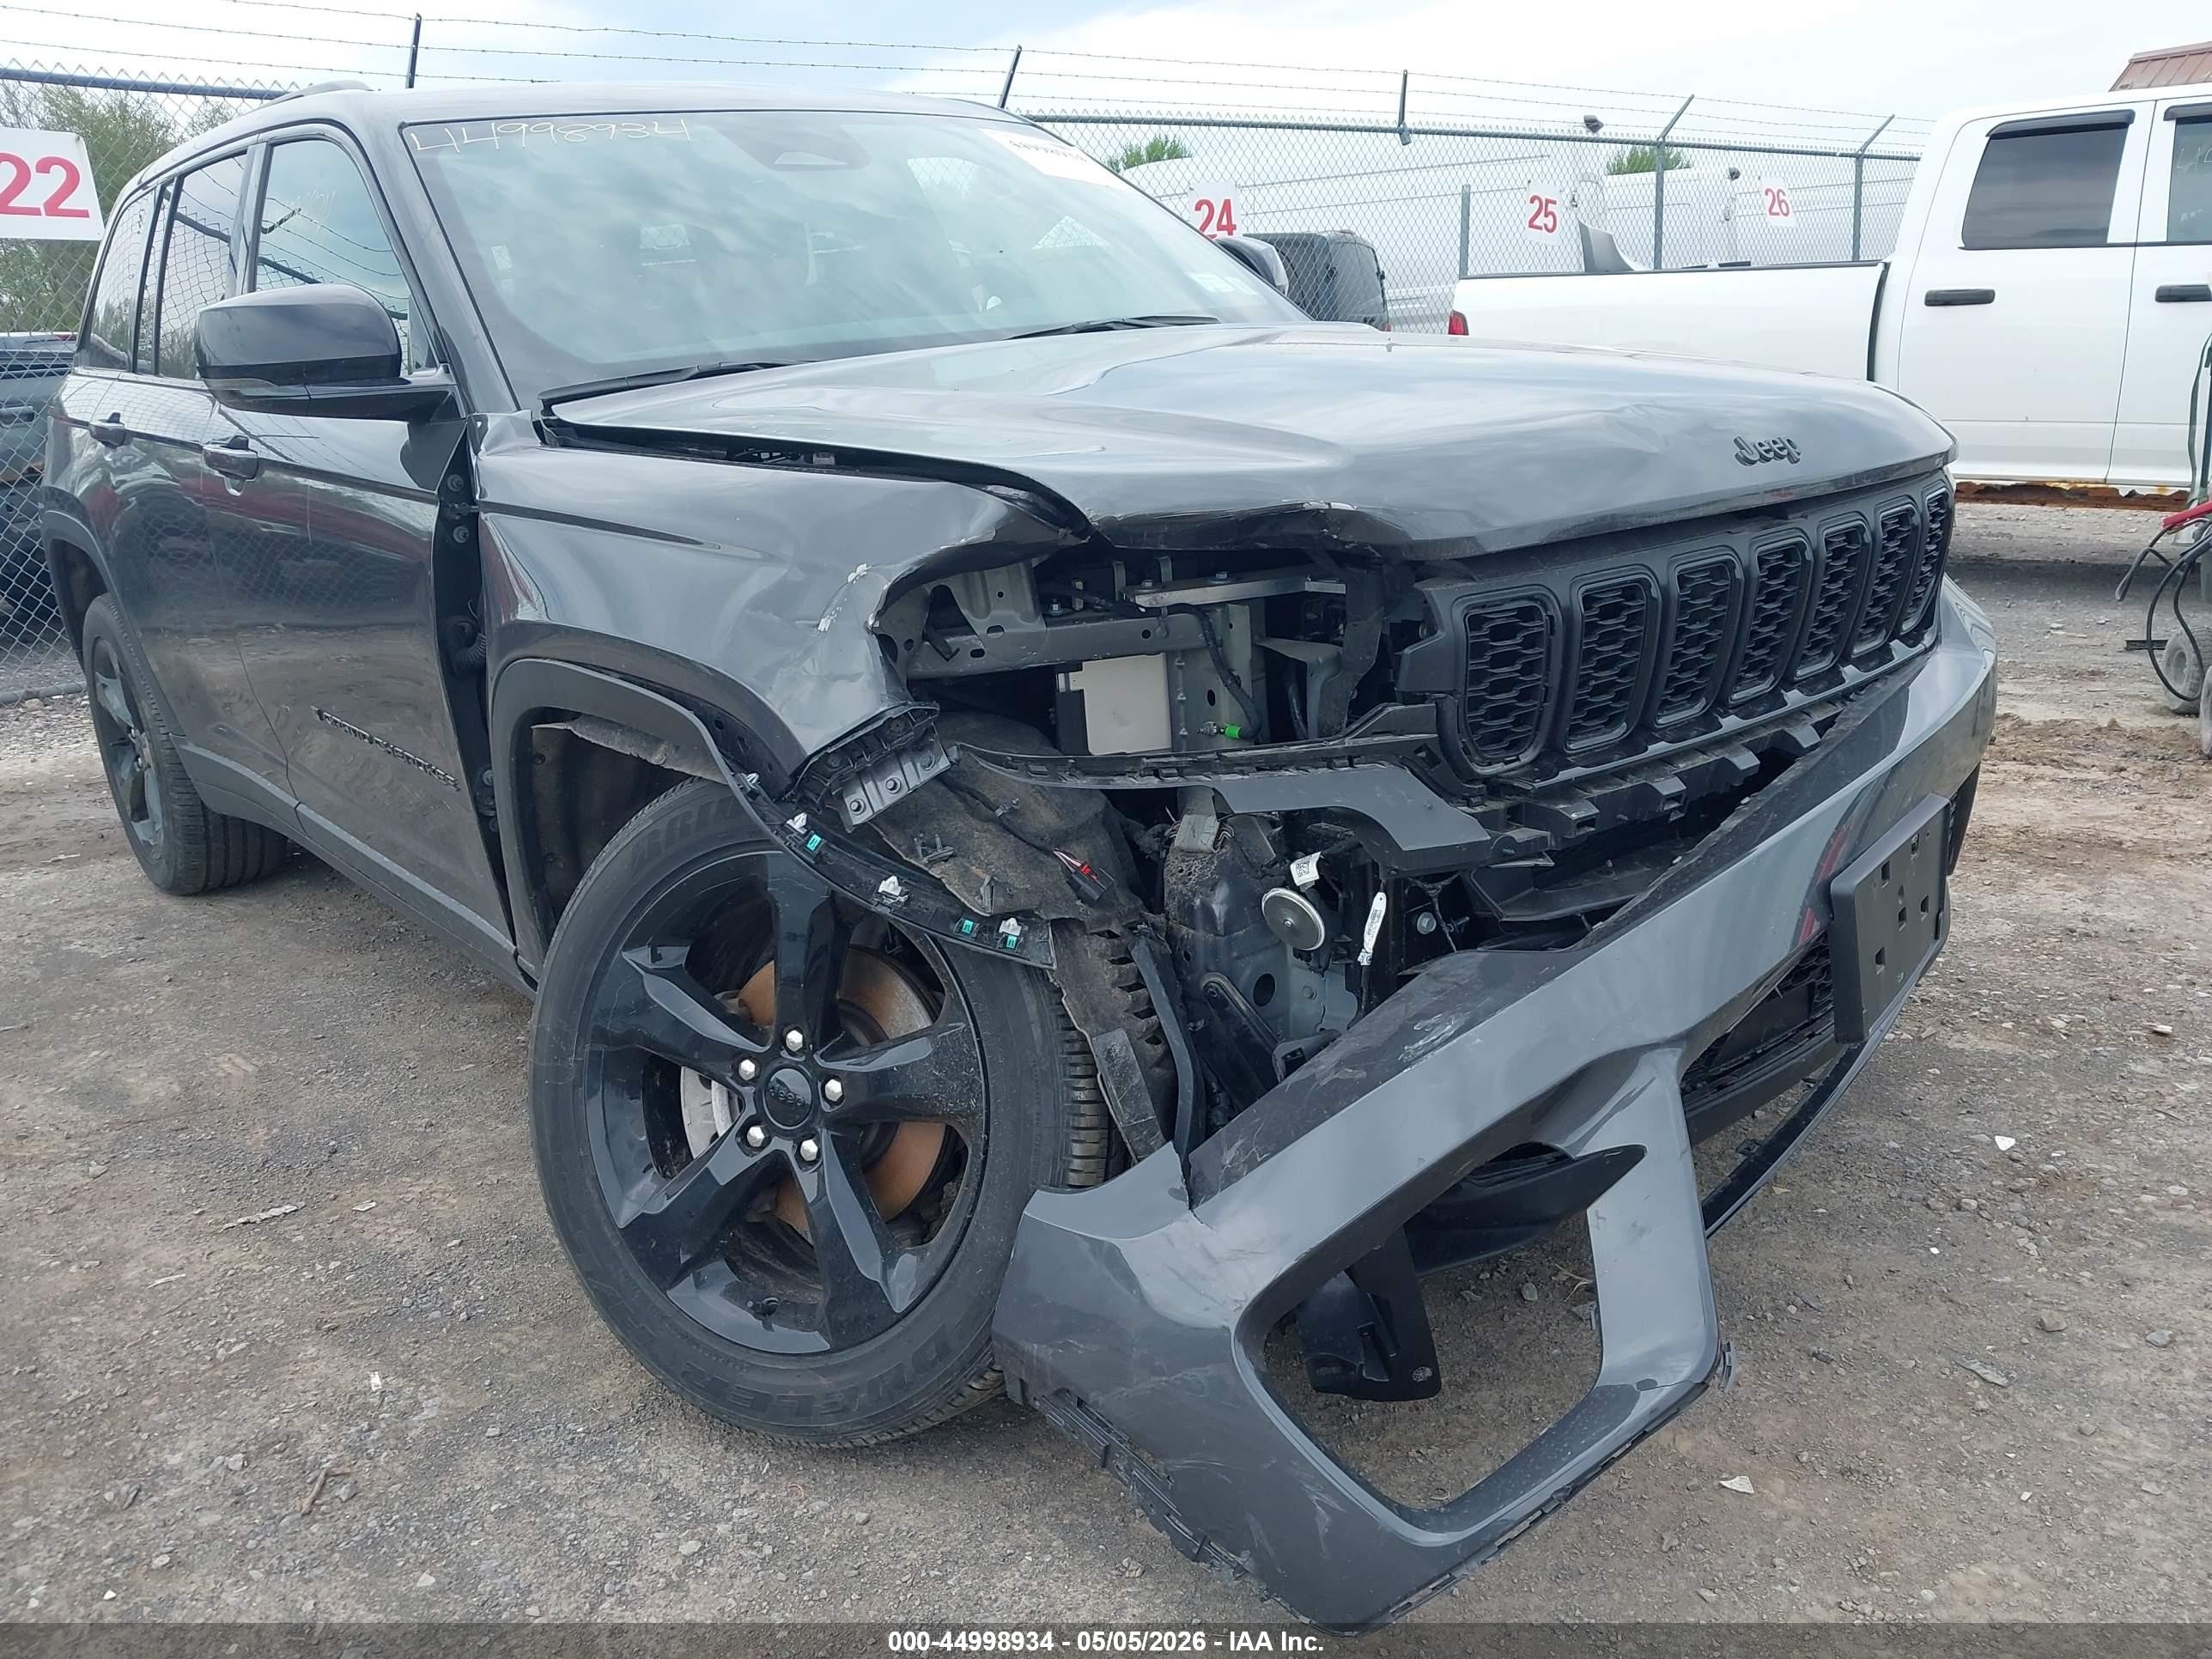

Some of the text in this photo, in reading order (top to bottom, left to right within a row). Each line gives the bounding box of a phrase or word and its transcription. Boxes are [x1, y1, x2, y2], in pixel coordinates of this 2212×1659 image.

[410, 118, 691, 153] 44998934
[0, 153, 89, 218] 22
[1765, 188, 1790, 216] 26
[1194, 199, 1237, 239] 24
[1528, 195, 1557, 233] 25
[1734, 436, 1801, 466] Jeep
